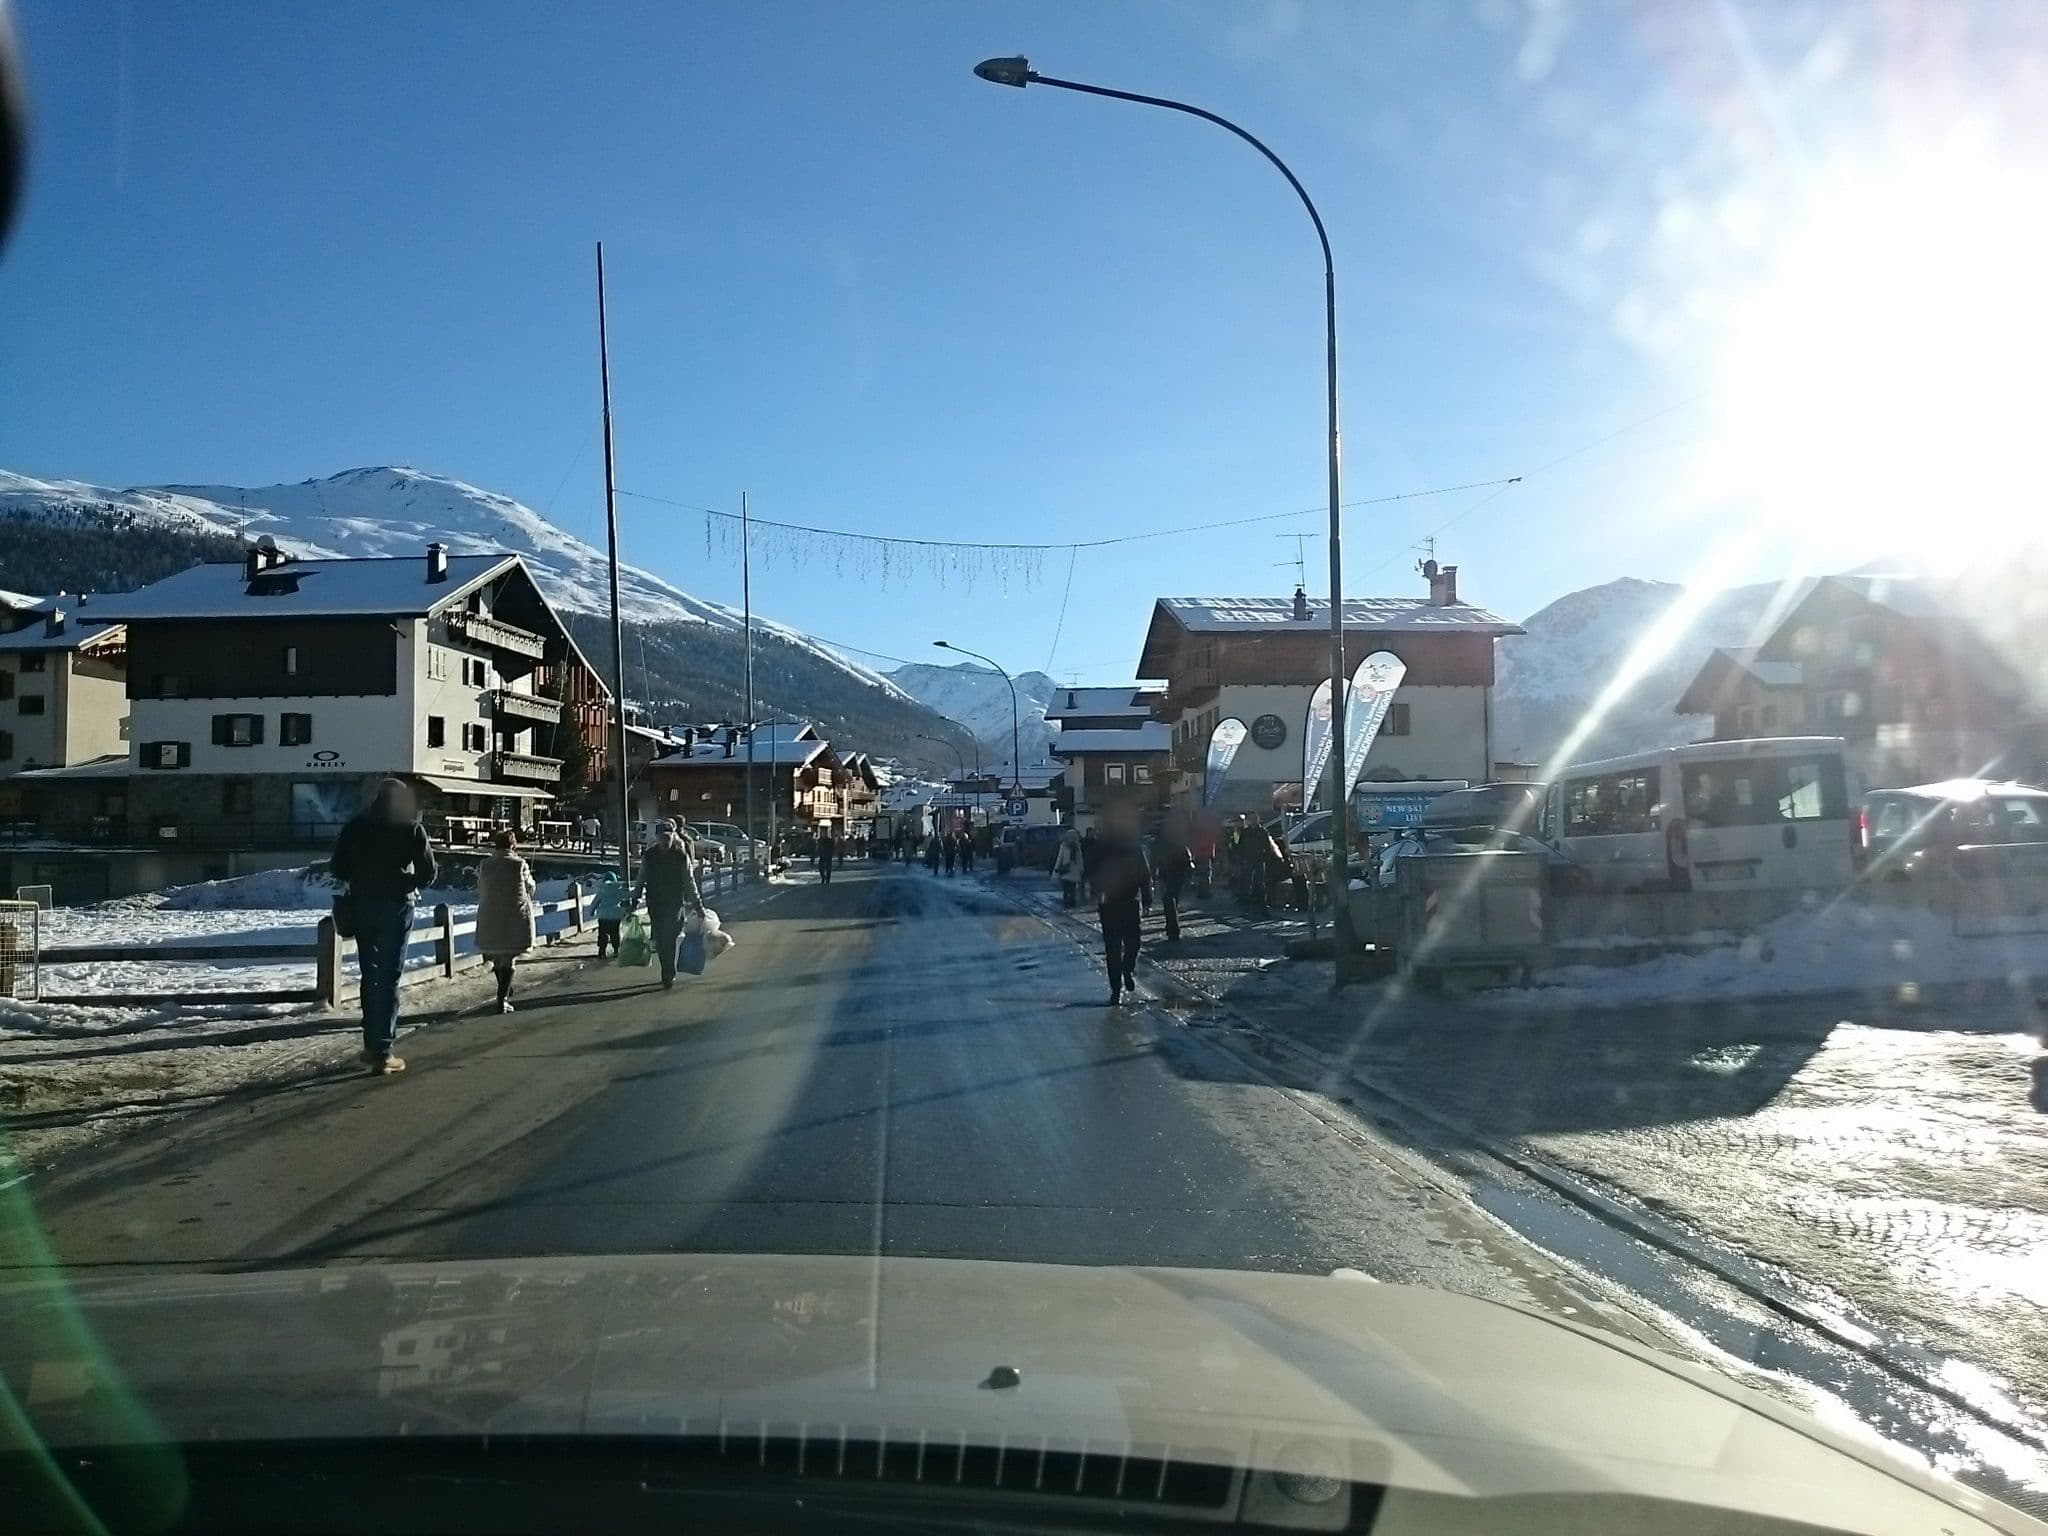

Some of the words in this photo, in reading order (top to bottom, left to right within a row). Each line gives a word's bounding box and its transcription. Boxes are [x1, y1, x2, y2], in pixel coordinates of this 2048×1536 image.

[1360, 723, 1378, 754] SCHOOL
[1374, 690, 1392, 723] LIVIGNO
[1012, 803, 1022, 814] P
[1408, 804, 1422, 812] SKI
